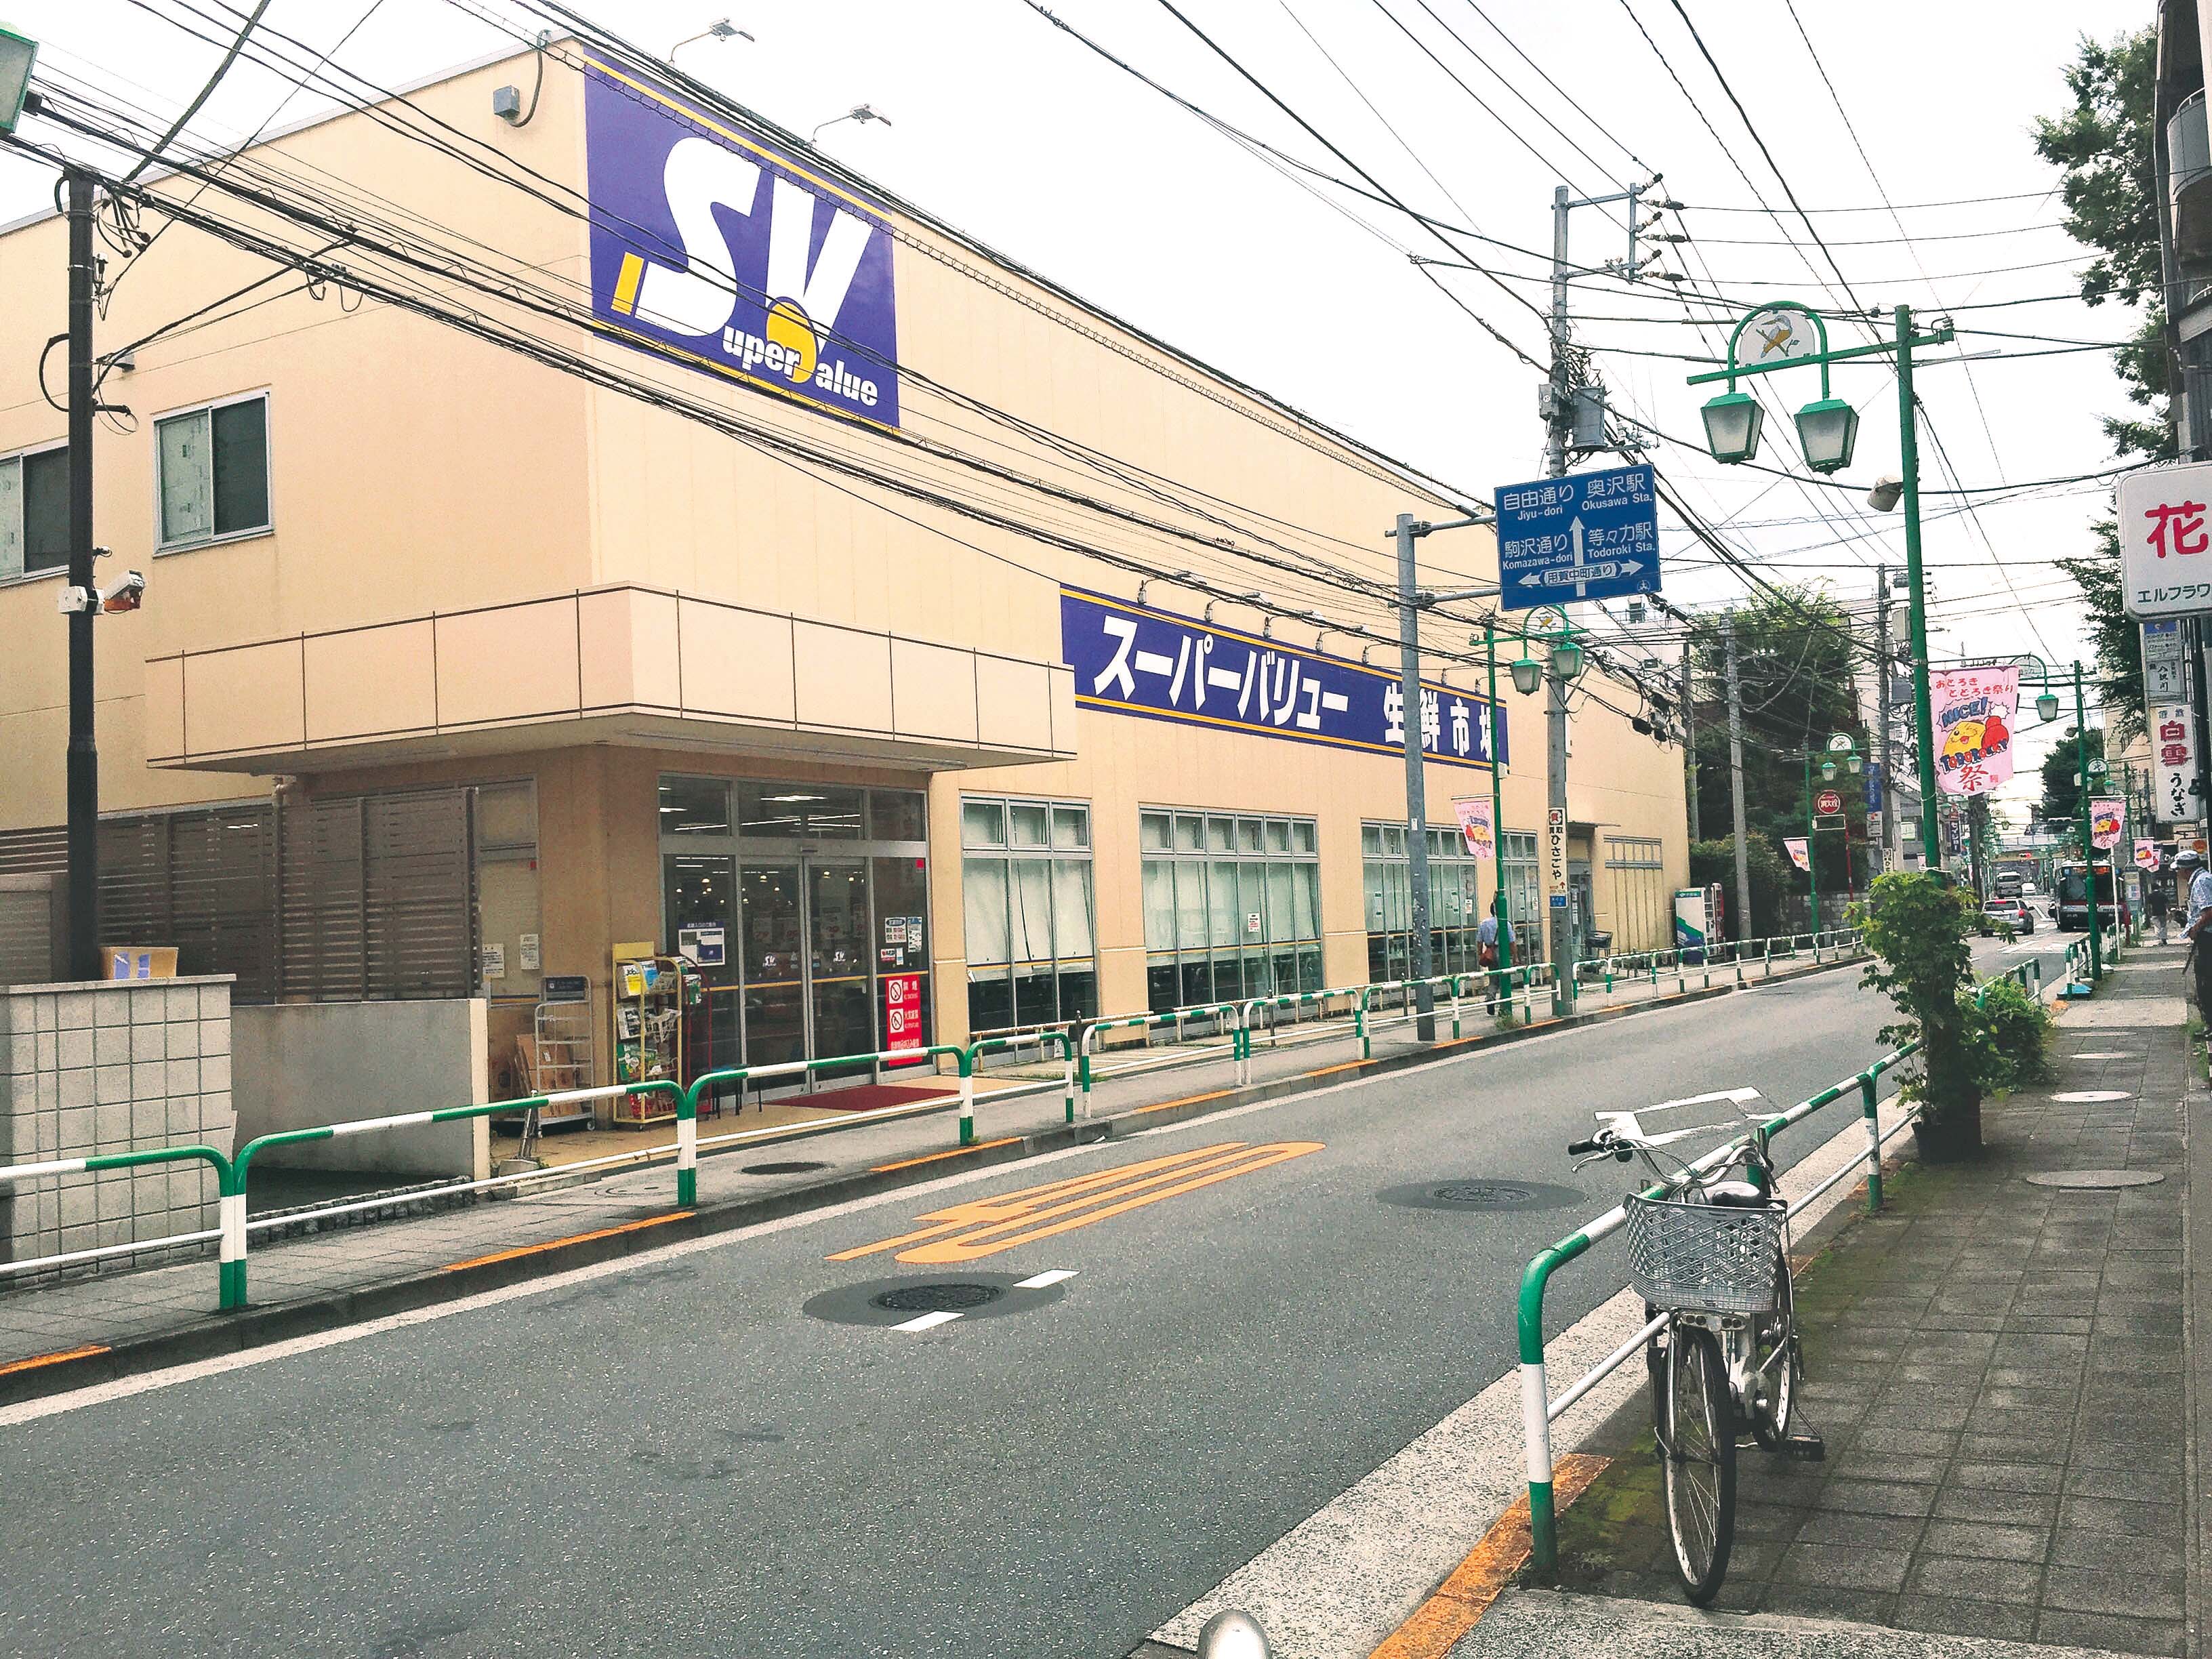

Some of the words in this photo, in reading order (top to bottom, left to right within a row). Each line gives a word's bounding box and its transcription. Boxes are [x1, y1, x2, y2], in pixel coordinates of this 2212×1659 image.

[1504, 484, 1574, 510] 自由通り
[1587, 473, 1645, 499] 奥沢駅
[1517, 506, 1563, 521] Jiyu-dori
[1582, 497, 1628, 511] Okusawa
[1632, 493, 1653, 504] Sta.
[1588, 522, 1654, 547] 等々力駅
[2144, 500, 2209, 559] 花
[1504, 533, 1568, 559] 駒沢通り
[1587, 544, 1631, 559] Todoroki
[1635, 542, 1656, 552] Sta.
[1502, 553, 1573, 570] Komazawa-dori
[1094, 615, 1349, 730] スーパーバリュー
[1942, 697, 1988, 728] NICE!
[2160, 720, 2192, 767] 白雪
[1957, 764, 1989, 792] 祭
[2170, 773, 2186, 817] うなぎ
